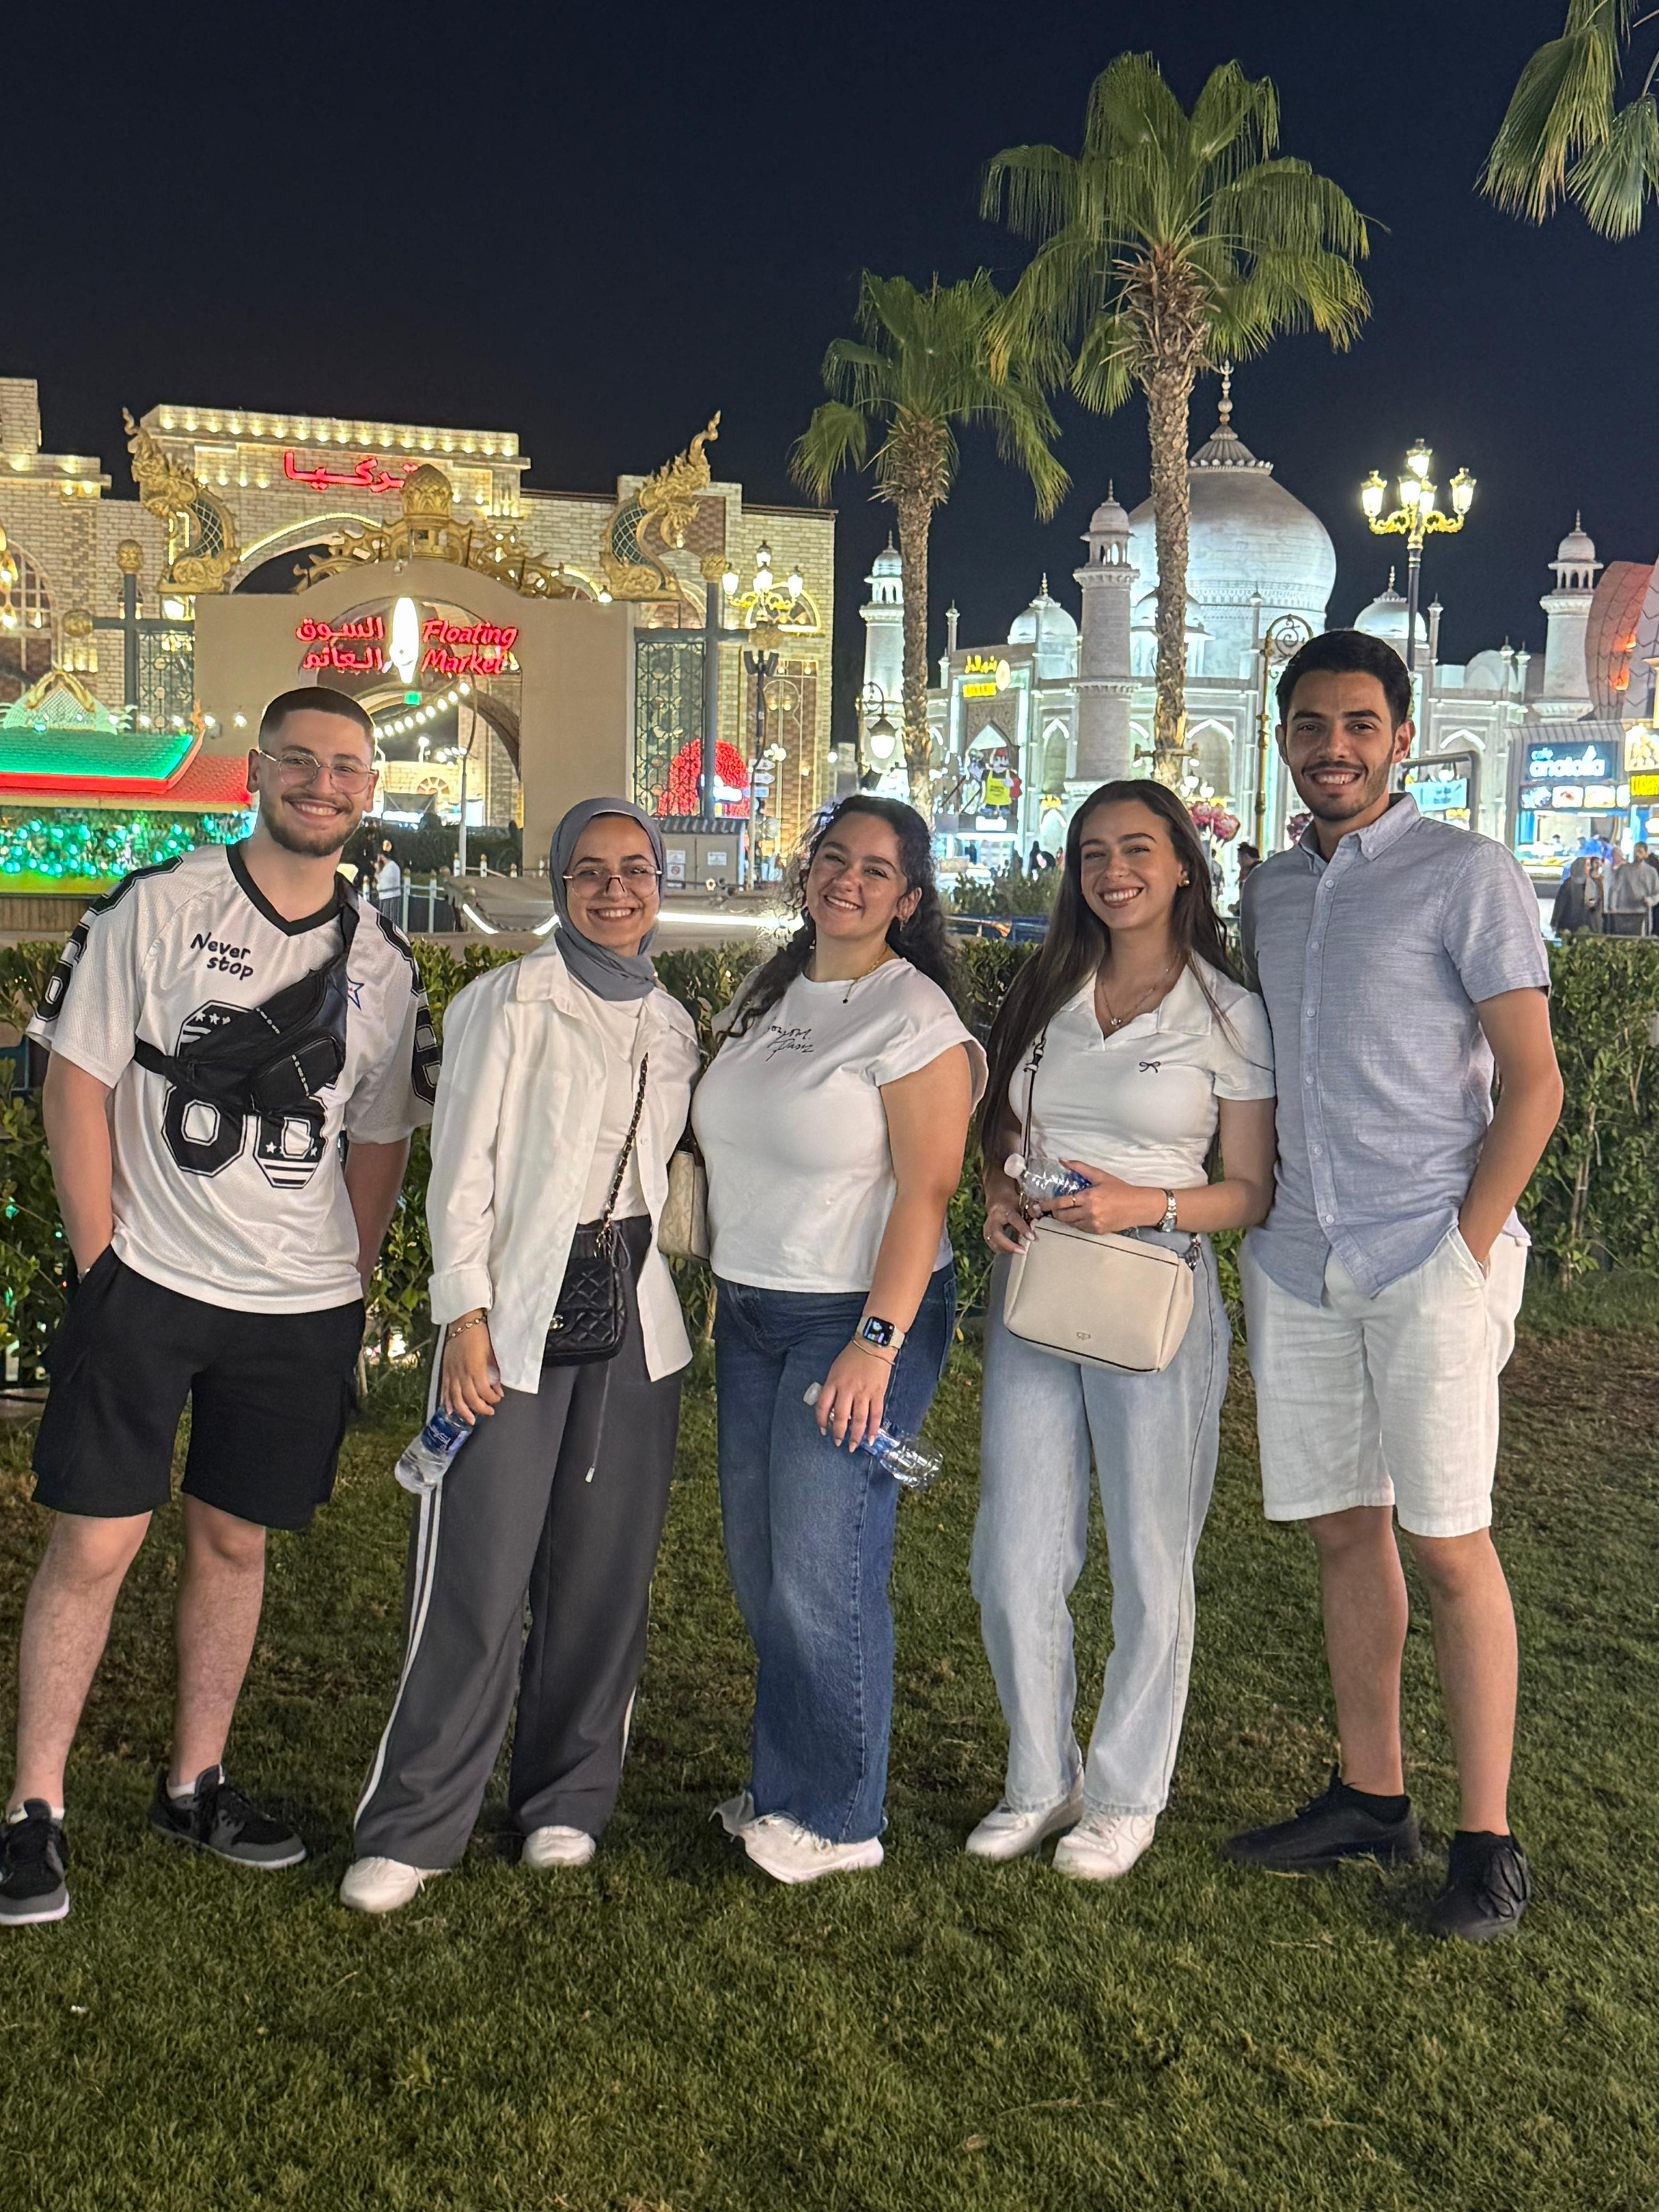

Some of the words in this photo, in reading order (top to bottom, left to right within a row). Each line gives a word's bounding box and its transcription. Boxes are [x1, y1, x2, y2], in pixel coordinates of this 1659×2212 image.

[284, 451, 419, 492] تركيا
[296, 616, 384, 641] السوق
[421, 618, 518, 651] Floating
[302, 646, 383, 671] العائم
[420, 647, 504, 675] Market
[190, 931, 251, 960] Never
[206, 956, 254, 981] stop
